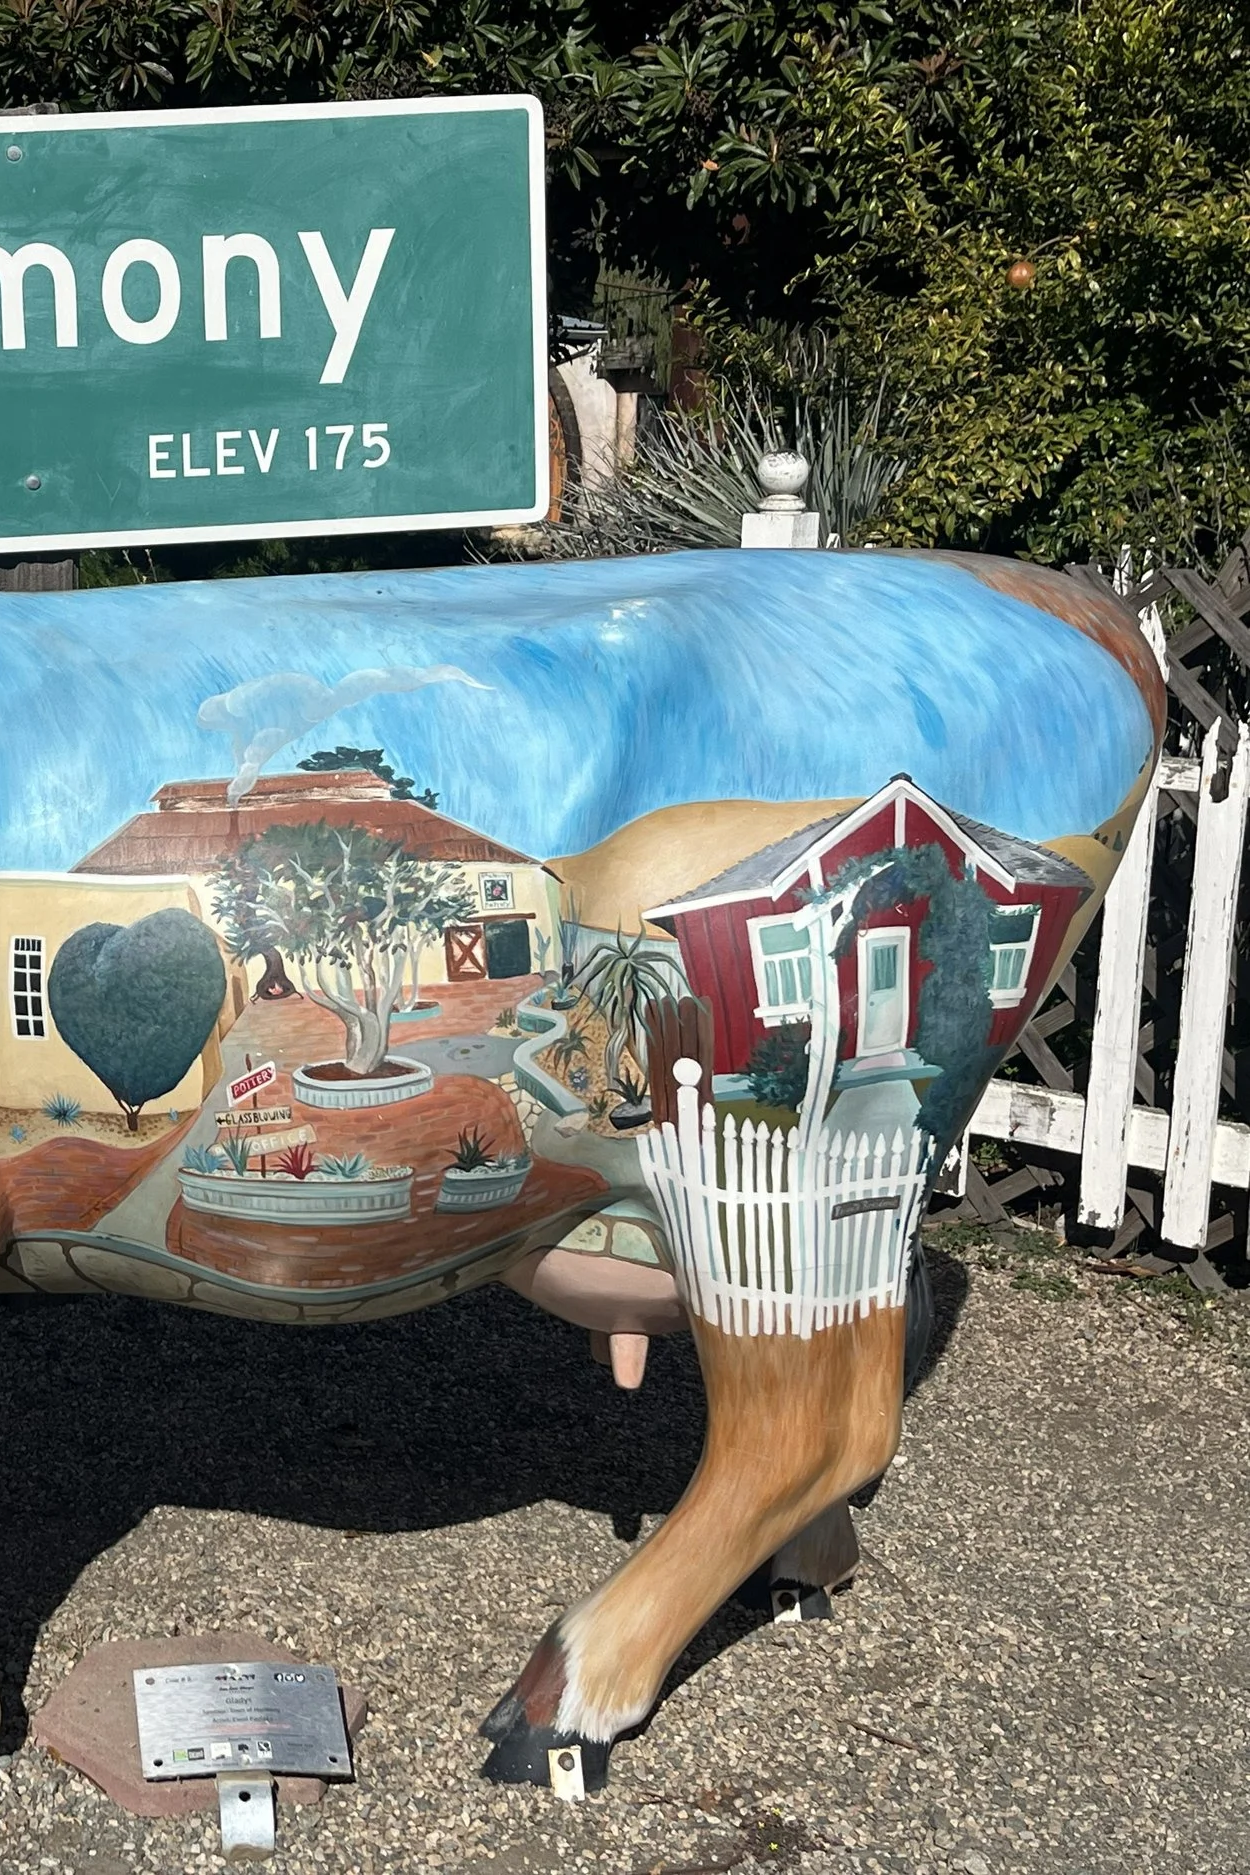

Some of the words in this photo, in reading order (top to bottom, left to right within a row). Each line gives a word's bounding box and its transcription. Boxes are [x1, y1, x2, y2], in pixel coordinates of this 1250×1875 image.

[148, 428, 280, 479] ELEV
[304, 422, 391, 471] 175
[233, 1067, 276, 1097] POTTERY
[225, 1108, 292, 1125] GLASSBLOWING
[252, 1128, 308, 1151] OFFICE
